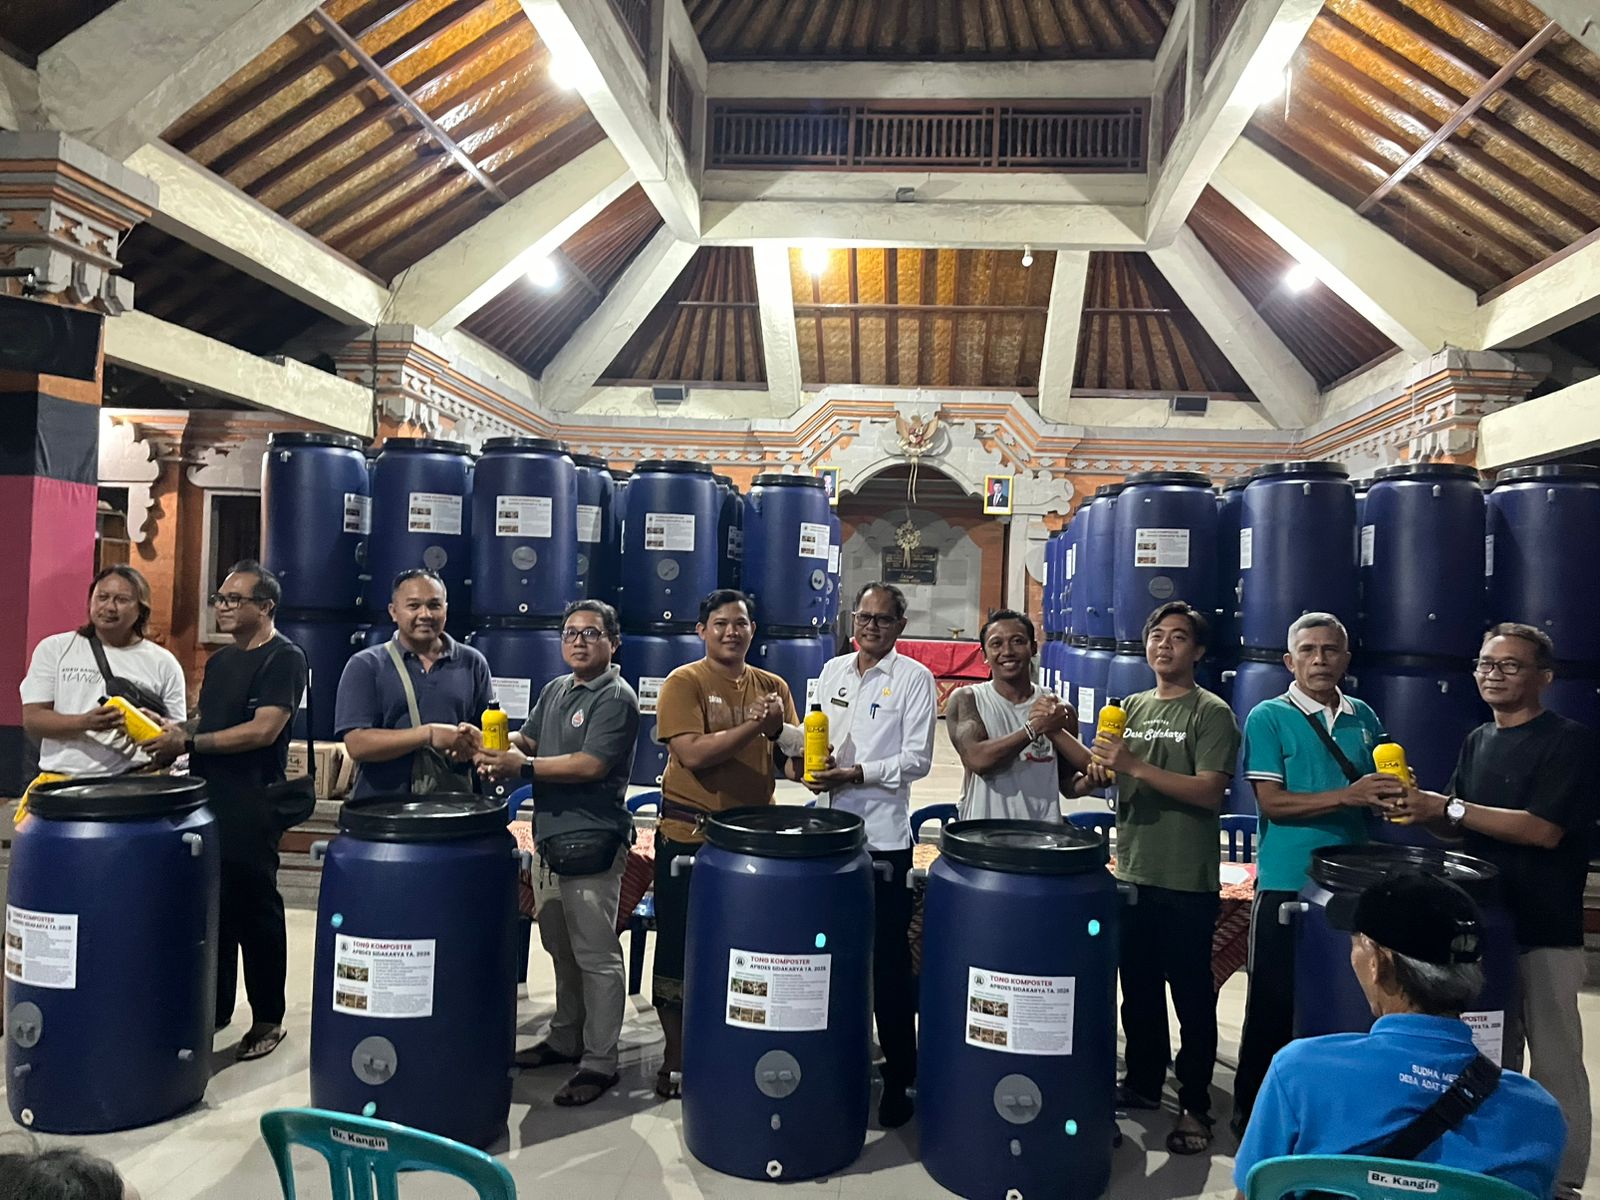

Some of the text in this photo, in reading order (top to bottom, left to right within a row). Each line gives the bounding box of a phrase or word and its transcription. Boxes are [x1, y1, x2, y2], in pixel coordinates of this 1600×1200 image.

[1123, 728, 1143, 738] Desa
[353, 941, 369, 949] TONG
[751, 956, 810, 965] TONG KOMPOSTER
[990, 975, 1053, 986] TONG KOMPOSTER
[990, 983, 1011, 991] APBDES
[1012, 986, 1045, 994] SIDAKARYA
[1412, 1064, 1440, 1080] SUDHA
[1421, 1079, 1441, 1091] ADAT
[332, 1129, 386, 1147] Br. Kangin
[1371, 1172, 1436, 1190] Br. Kangin
